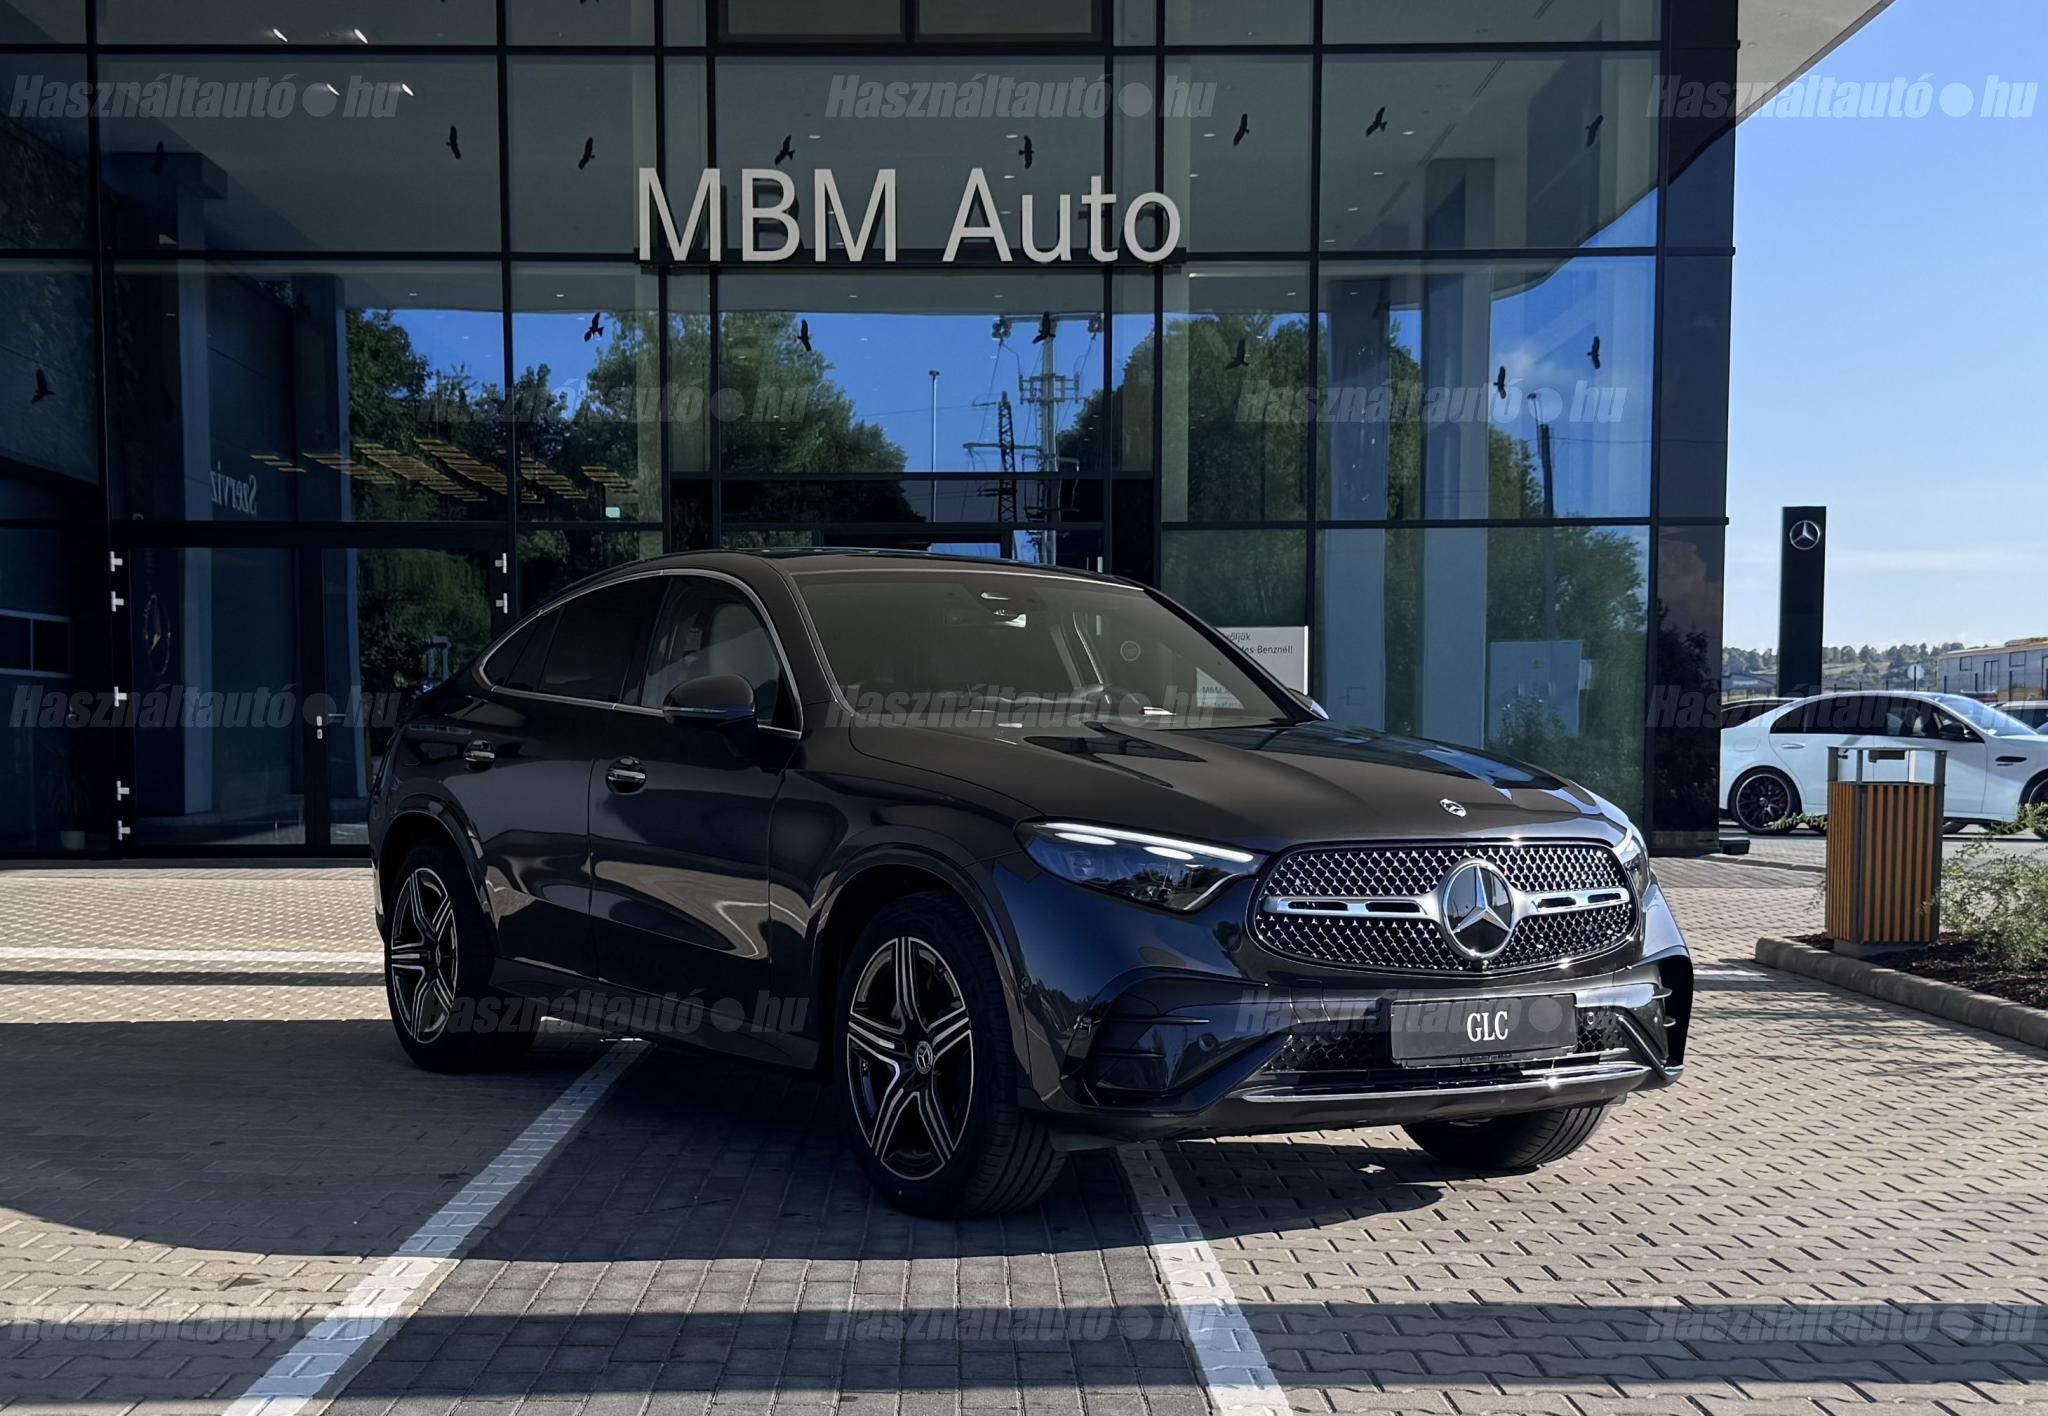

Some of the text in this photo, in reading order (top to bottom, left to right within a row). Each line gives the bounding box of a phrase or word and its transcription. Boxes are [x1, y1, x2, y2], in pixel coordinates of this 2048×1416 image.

[638, 167, 1181, 264] MBM Auto
[1466, 1011, 1509, 1042] GLC
